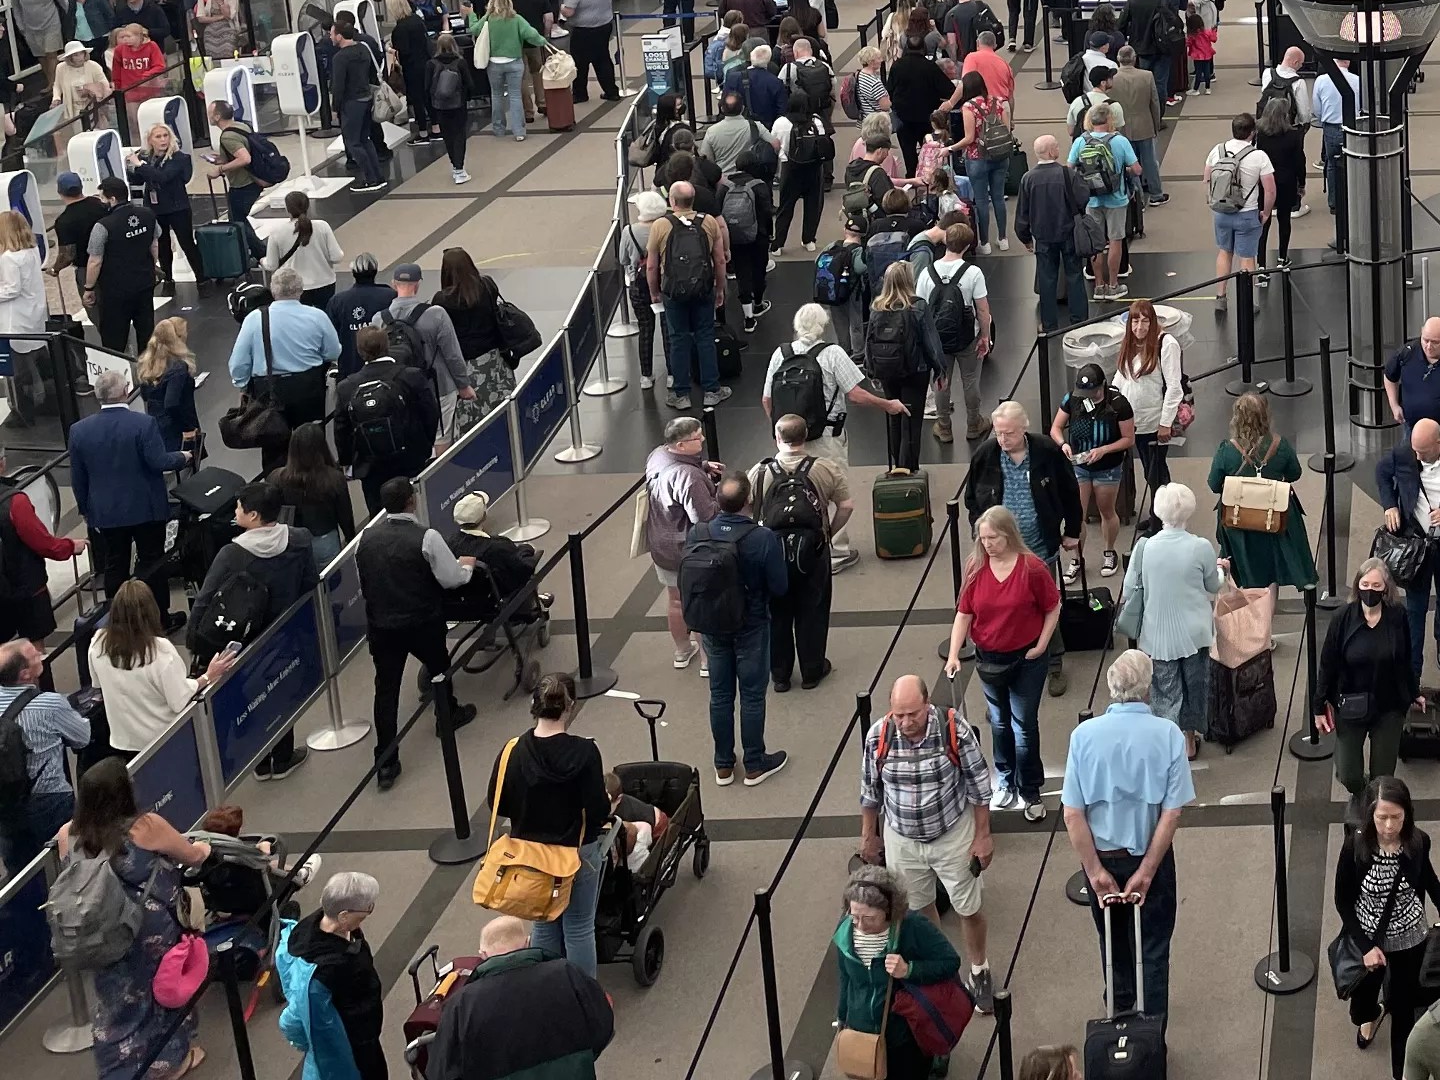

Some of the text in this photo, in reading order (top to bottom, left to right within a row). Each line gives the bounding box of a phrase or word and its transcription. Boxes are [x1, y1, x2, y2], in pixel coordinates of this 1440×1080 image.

[125, 226, 147, 238] CLEAR
[87, 361, 103, 376] TSA
[540, 384, 556, 409] CLEAR
